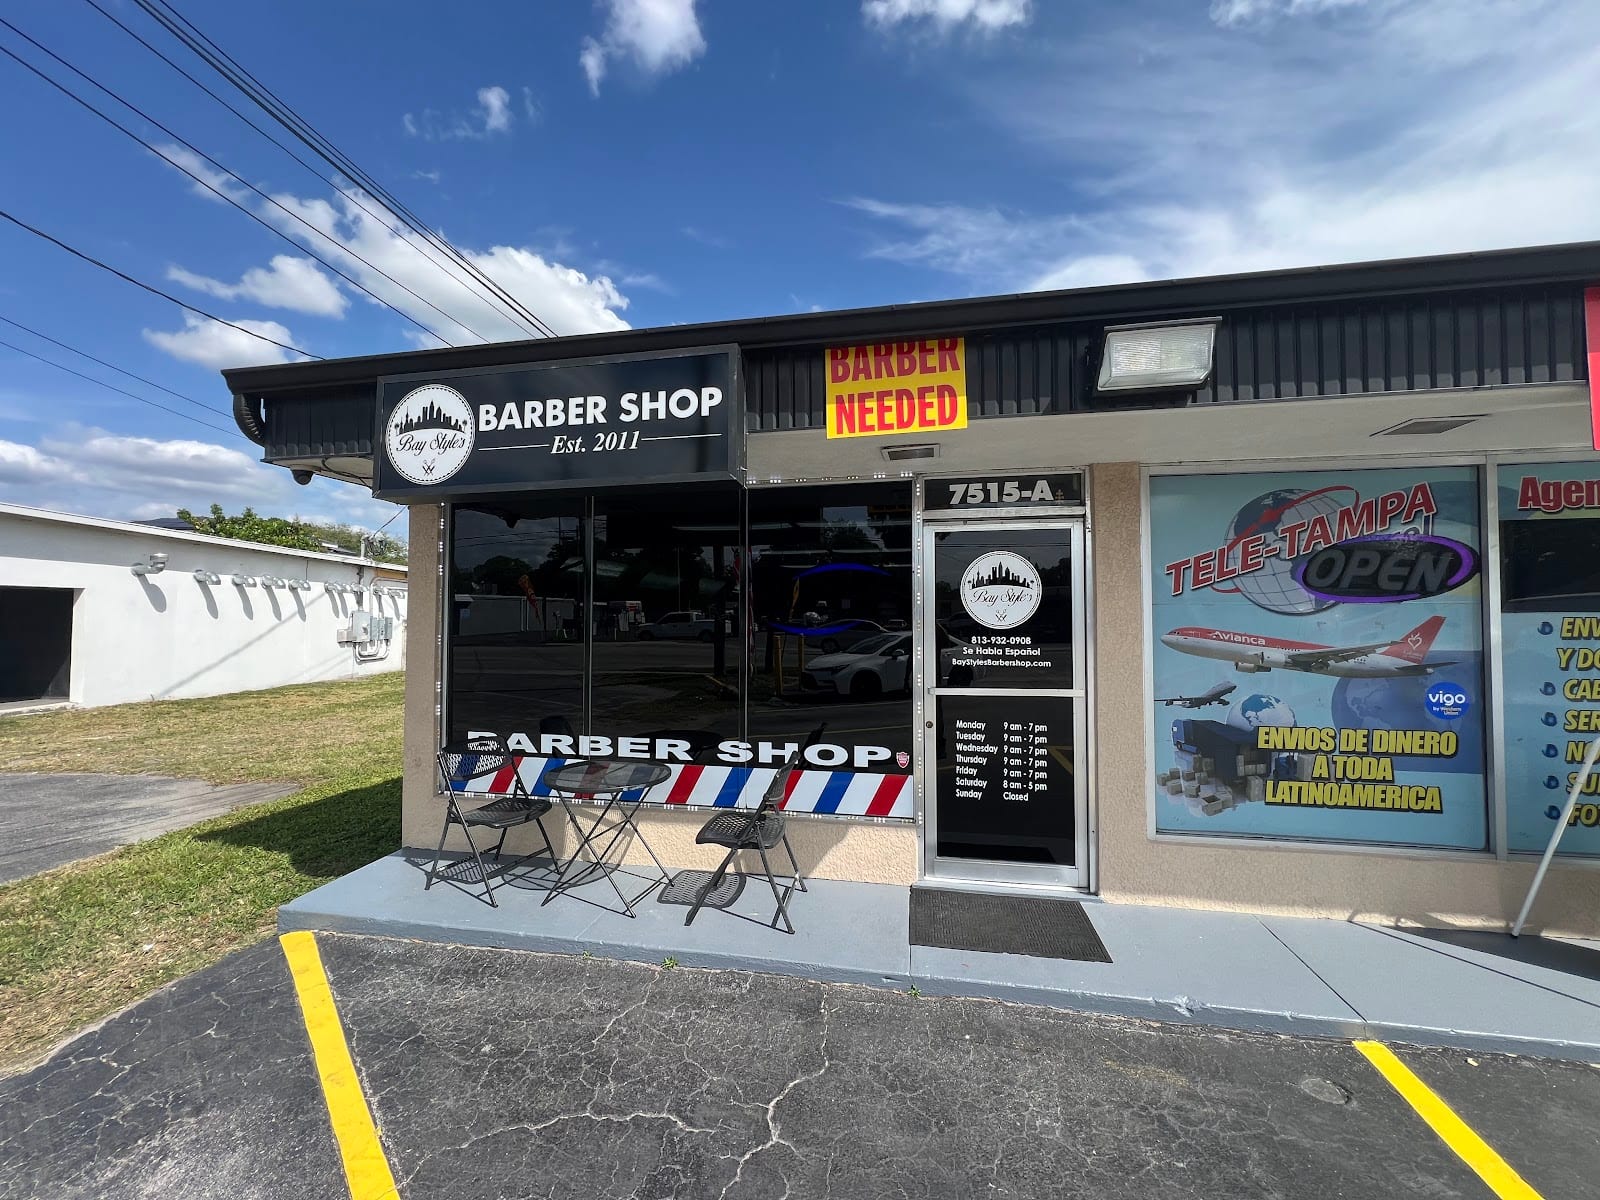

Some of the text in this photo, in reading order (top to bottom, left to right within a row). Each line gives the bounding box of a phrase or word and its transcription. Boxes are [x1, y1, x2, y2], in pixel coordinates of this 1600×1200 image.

[831, 338, 960, 383] BARBER
[478, 386, 723, 432] BARBER SHOP
[835, 384, 958, 435] NEEDED
[396, 433, 427, 456] Bay
[550, 430, 640, 455] Est. 2011
[949, 480, 1055, 505] 7515-A
[1165, 481, 1437, 597] TELE-TAMPA
[1305, 549, 1453, 593] OPEN
[970, 588, 998, 608] Bay
[971, 636, 1032, 645] 813-932-0908
[1207, 630, 1267, 646] Avianca
[952, 658, 1052, 668] BayStylesBarbershop.com
[962, 647, 1041, 657] Se Habla Español
[1556, 648, 1575, 671] Y
[1428, 690, 1466, 706] vigo
[955, 720, 986, 731] Monday
[1003, 722, 1009, 730] 9
[1028, 723, 1034, 731] 7
[1034, 724, 1048, 733] pm
[955, 731, 986, 742] Tuesday
[1003, 734, 1009, 742] 9
[1028, 734, 1034, 743] 7
[1034, 736, 1048, 745] pm
[467, 731, 693, 761] ARBER
[716, 741, 892, 768] SHOP
[955, 742, 999, 754] Wednesday
[1003, 745, 1009, 754] 9
[1028, 746, 1034, 754] 7
[1034, 748, 1048, 756] pm
[1257, 726, 1458, 757] ENVIOS DE DINERO
[955, 754, 988, 765] Thursday
[1003, 757, 1009, 766] 9
[1028, 758, 1034, 766] 7
[1034, 760, 1048, 768] pm
[1311, 756, 1394, 782] A TODA
[955, 766, 978, 777] Friday
[1003, 768, 1009, 777] 9
[1028, 769, 1034, 778] 7
[1034, 771, 1048, 780] pm
[955, 777, 988, 788] Saturday
[1003, 780, 1009, 788] 8
[1028, 781, 1034, 789] 5
[1034, 782, 1048, 791] pm
[955, 789, 1029, 801] Sunday Closed
[1264, 780, 1443, 813] LATINOAMERICA
[1567, 803, 1600, 827] FO
